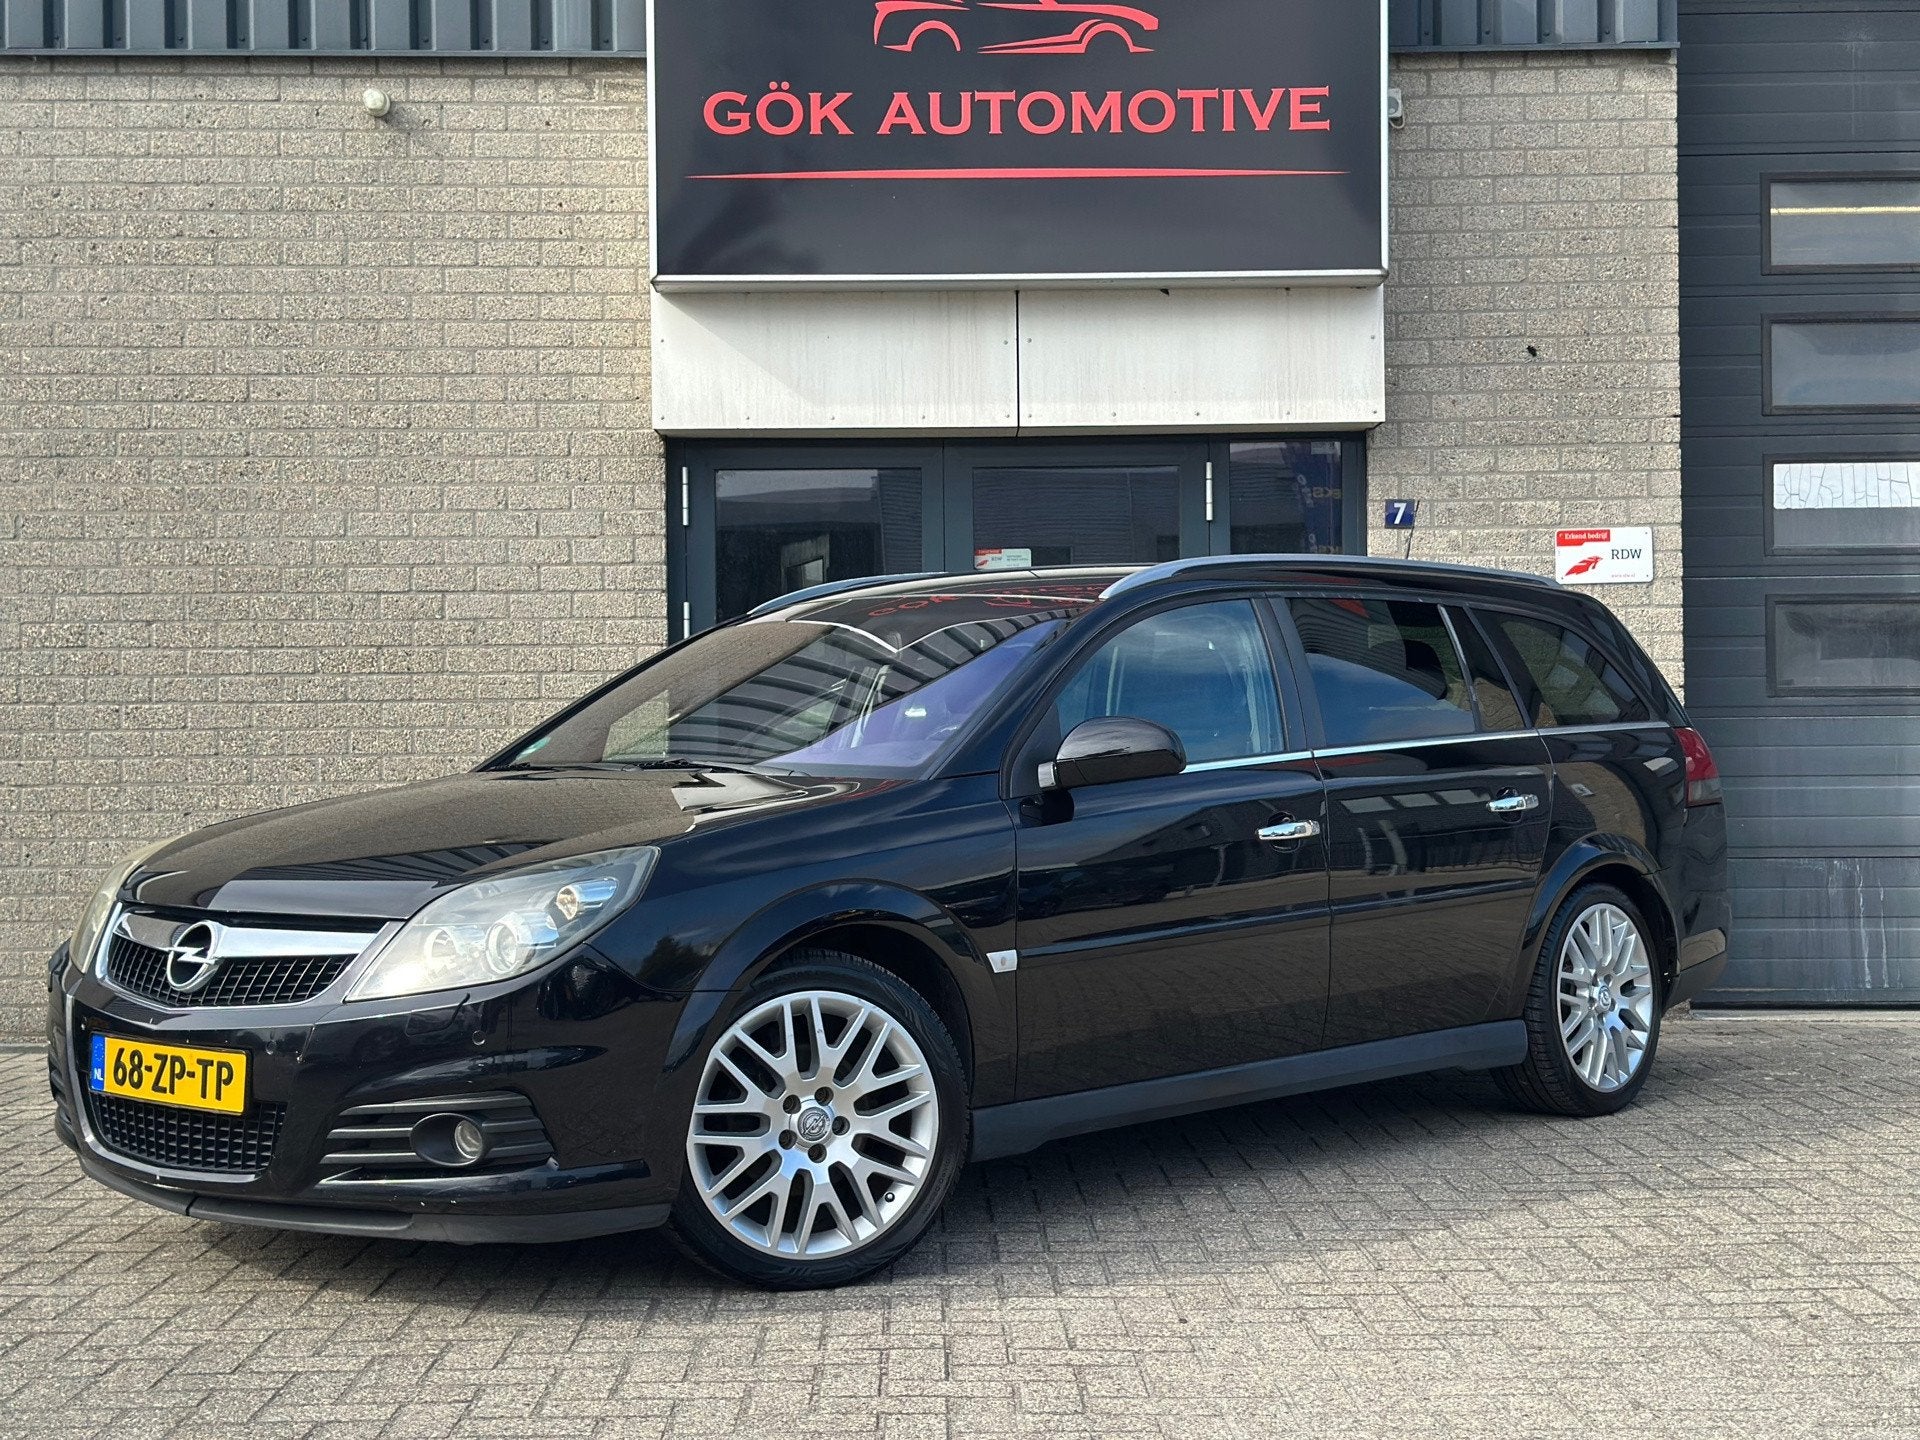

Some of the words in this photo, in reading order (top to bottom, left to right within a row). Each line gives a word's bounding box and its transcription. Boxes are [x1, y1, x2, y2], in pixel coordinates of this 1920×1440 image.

[703, 81, 854, 136] GÖK
[877, 86, 1331, 135] AUTOMOTIVE
[1393, 502, 1407, 525] 7
[1587, 531, 1608, 541] bedrijf
[1611, 548, 1642, 560] RDW
[93, 1068, 104, 1081] NL
[113, 1047, 234, 1101] 68-ZP-TP
